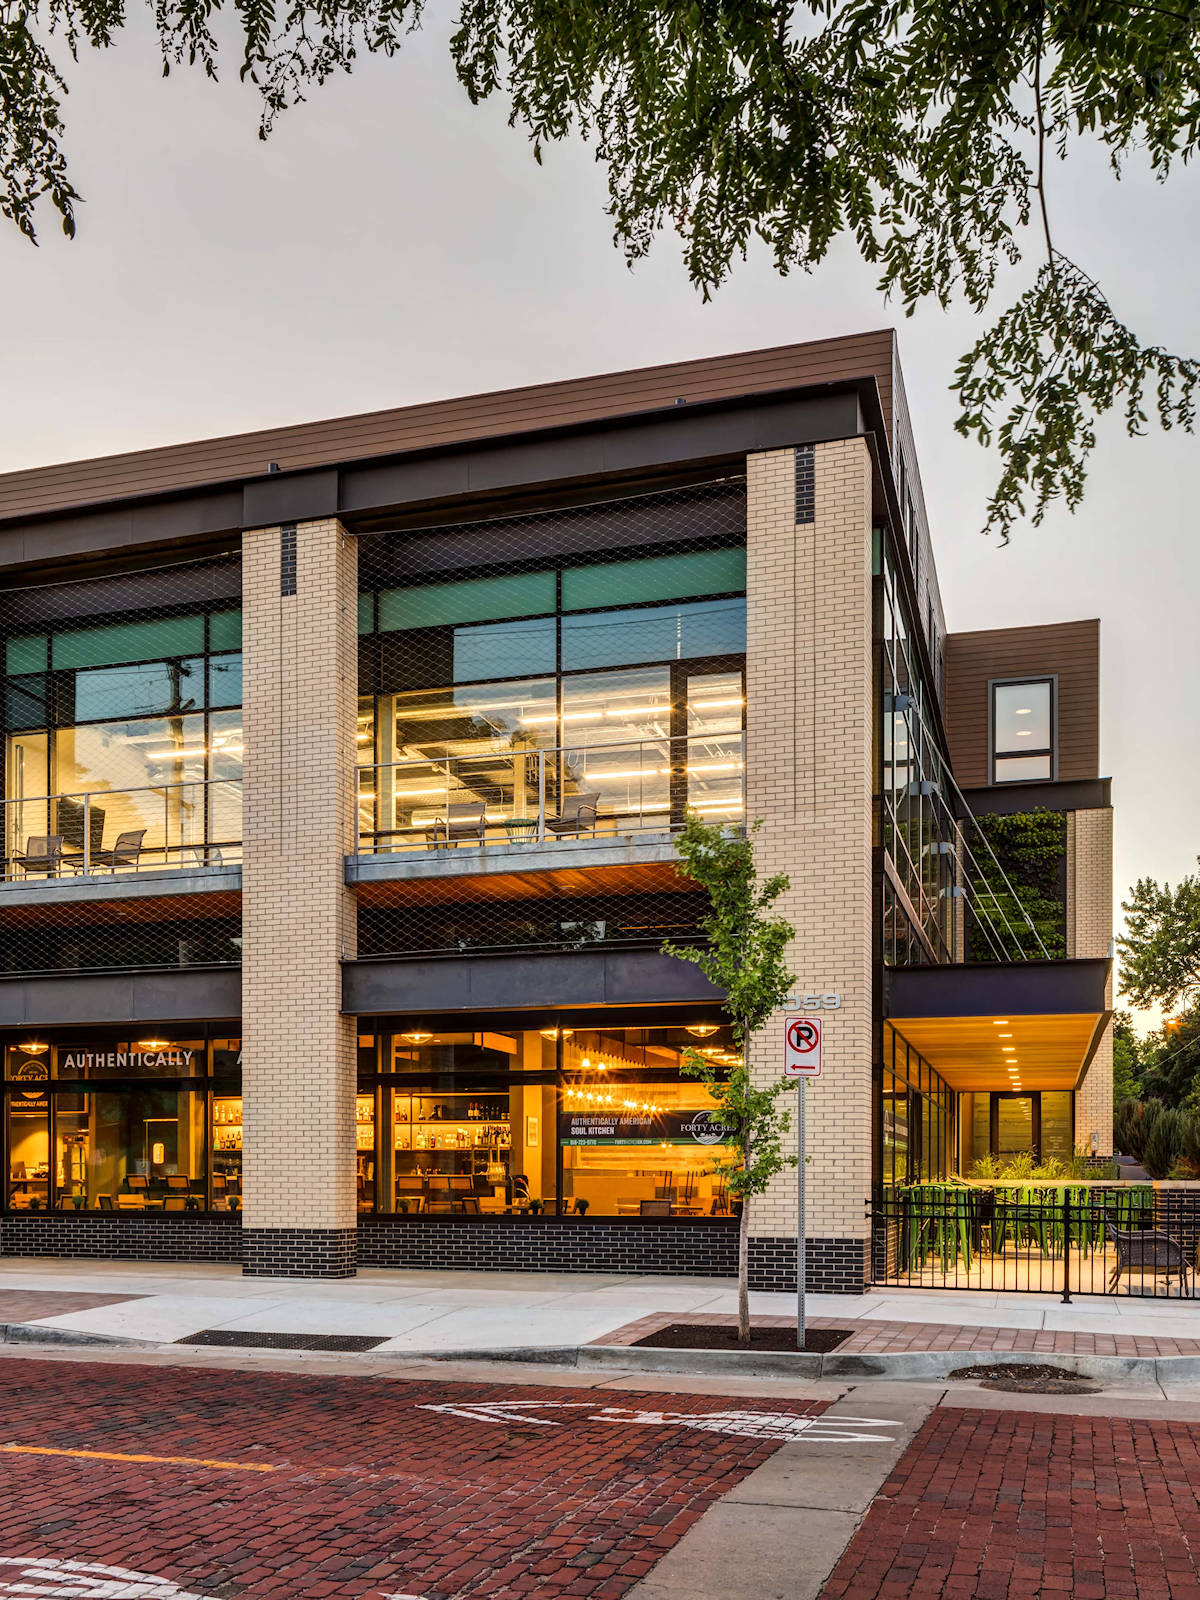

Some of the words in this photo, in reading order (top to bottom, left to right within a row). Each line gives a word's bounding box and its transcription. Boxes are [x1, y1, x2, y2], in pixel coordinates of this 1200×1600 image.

[796, 1026, 813, 1047] P
[64, 1050, 193, 1069] AUTHENTICALLY
[571, 1117, 618, 1126] AUTHENTICALLY
[619, 1117, 652, 1125] AMERICAN
[571, 1126, 587, 1135] SOUL
[588, 1126, 615, 1135] KITCHEN
[680, 1123, 708, 1132] FORTY
